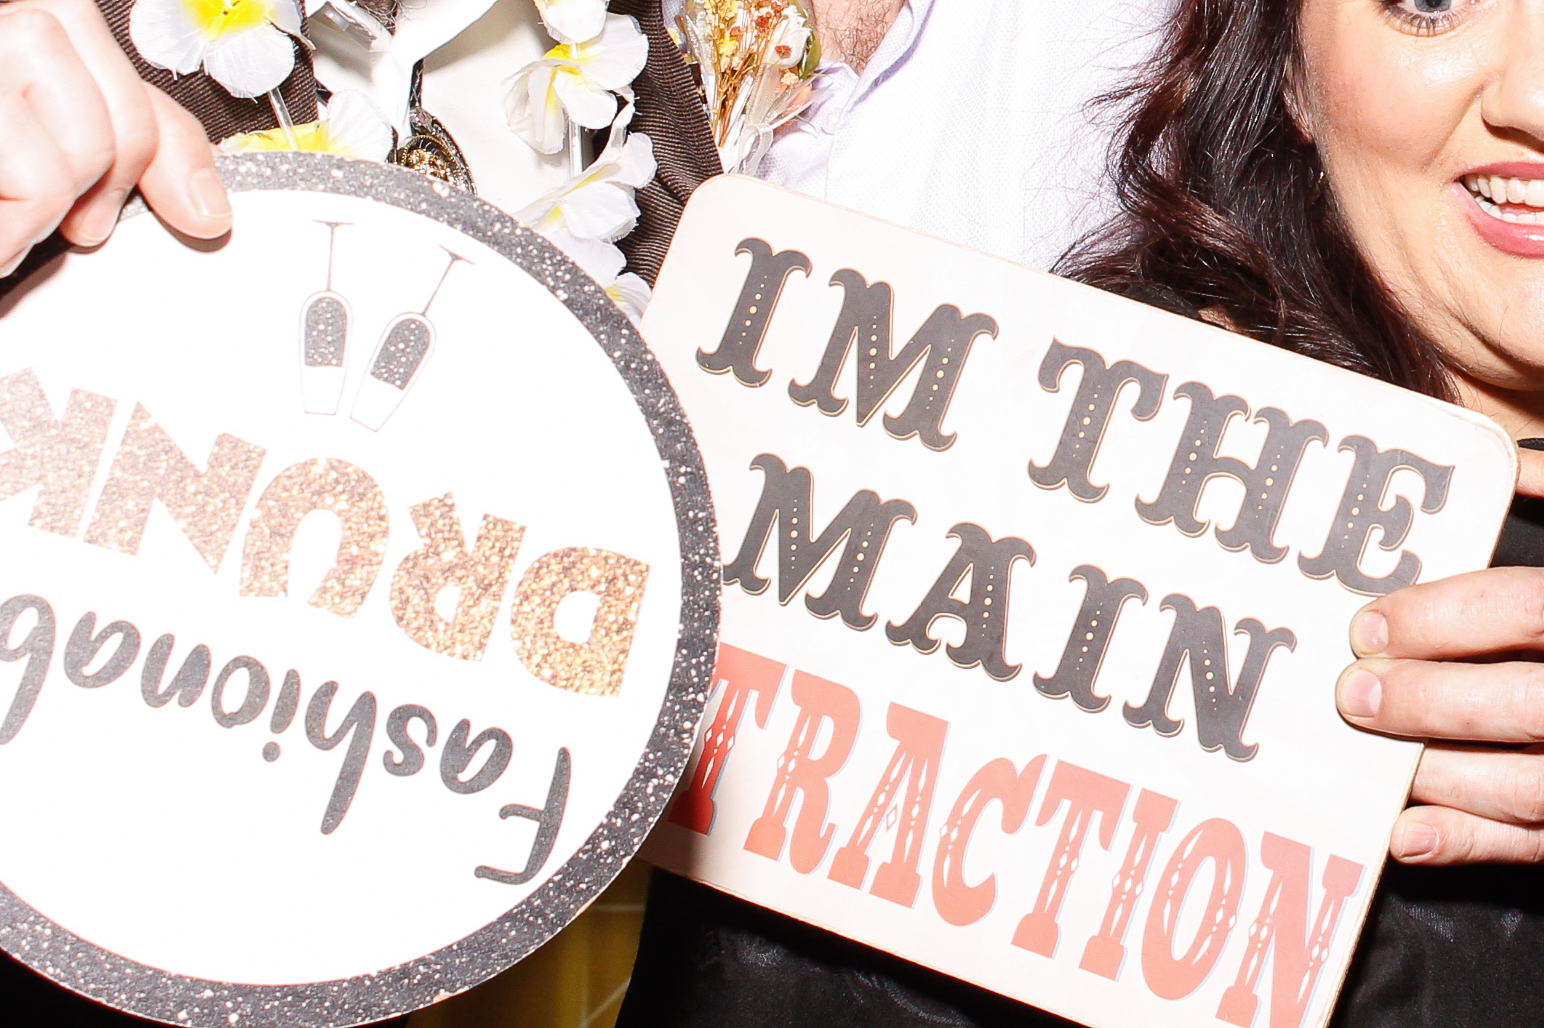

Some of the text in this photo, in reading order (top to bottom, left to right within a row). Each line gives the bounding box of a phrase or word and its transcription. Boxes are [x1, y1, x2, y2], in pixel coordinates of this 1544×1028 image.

[0, 367, 650, 697] DRUNK
[695, 236, 1457, 597] IM THE
[0, 594, 571, 886] Fashionab
[722, 452, 1298, 763] MAIN
[667, 641, 1368, 1028] TRACTION
